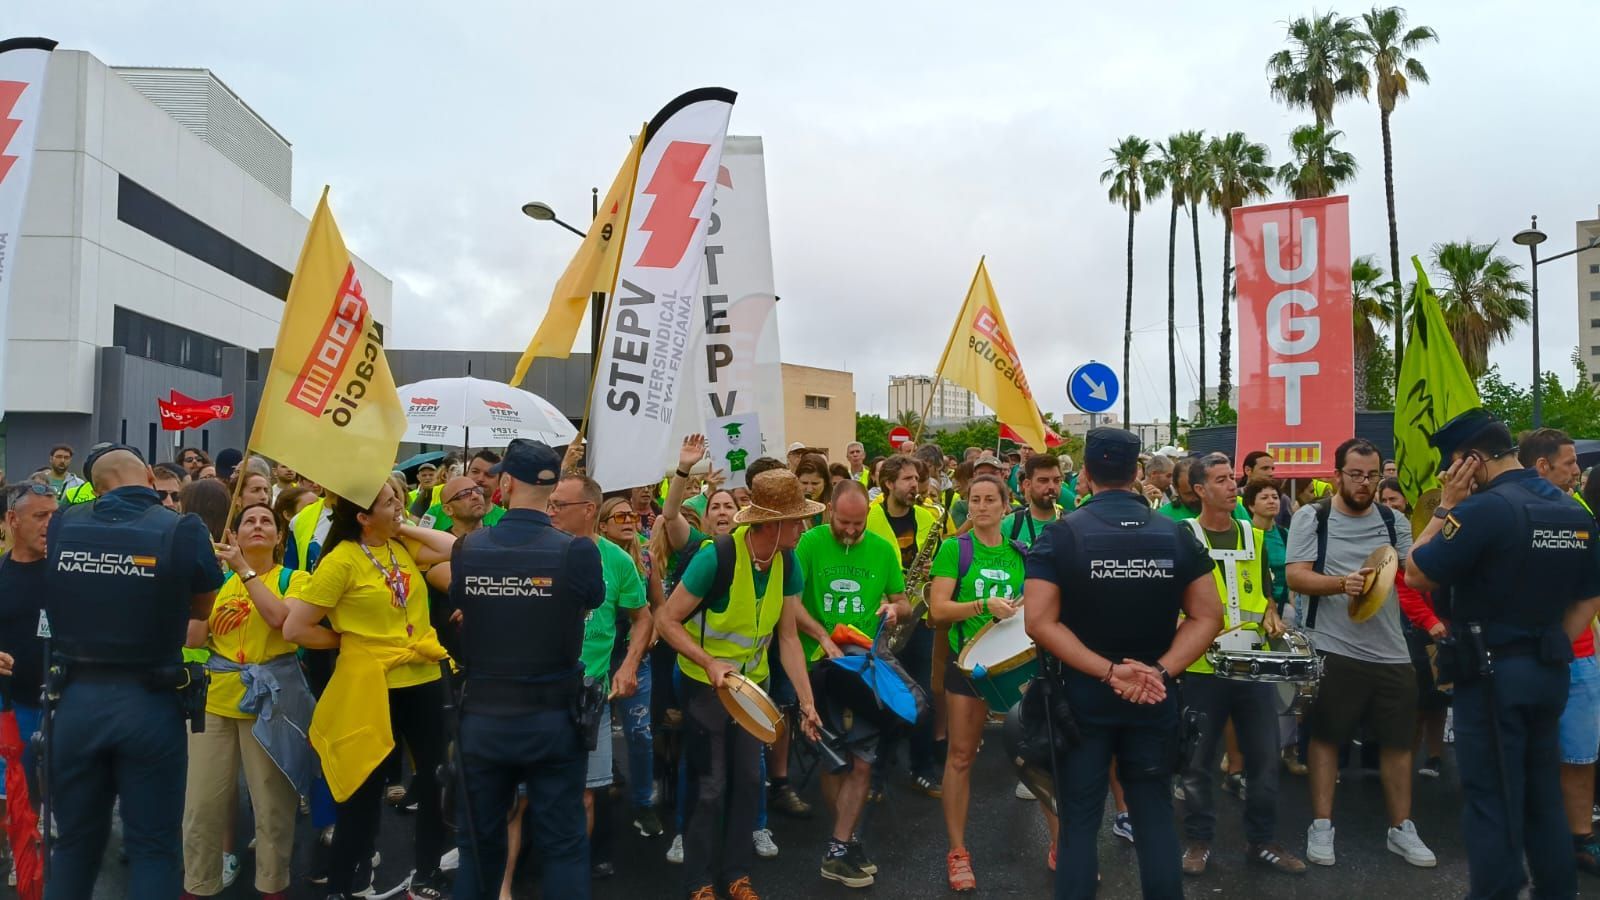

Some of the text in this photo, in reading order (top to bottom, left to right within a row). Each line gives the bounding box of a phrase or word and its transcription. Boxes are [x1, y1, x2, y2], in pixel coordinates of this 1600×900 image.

[1262, 216, 1321, 426] UGT
[606, 278, 656, 416] STEPV
[645, 289, 678, 421] INTERSINDICAL
[489, 408, 519, 417] STEPV
[1533, 530, 1577, 539] POLICIA
[1532, 540, 1587, 549] NACIONAL
[59, 551, 135, 565] POLICIA
[1091, 559, 1157, 569] POLICIA
[57, 562, 155, 577] NACIONAL
[1091, 569, 1174, 579] NACIONAL
[465, 576, 533, 586] POLICIA
[465, 586, 552, 597] NACIONAL
